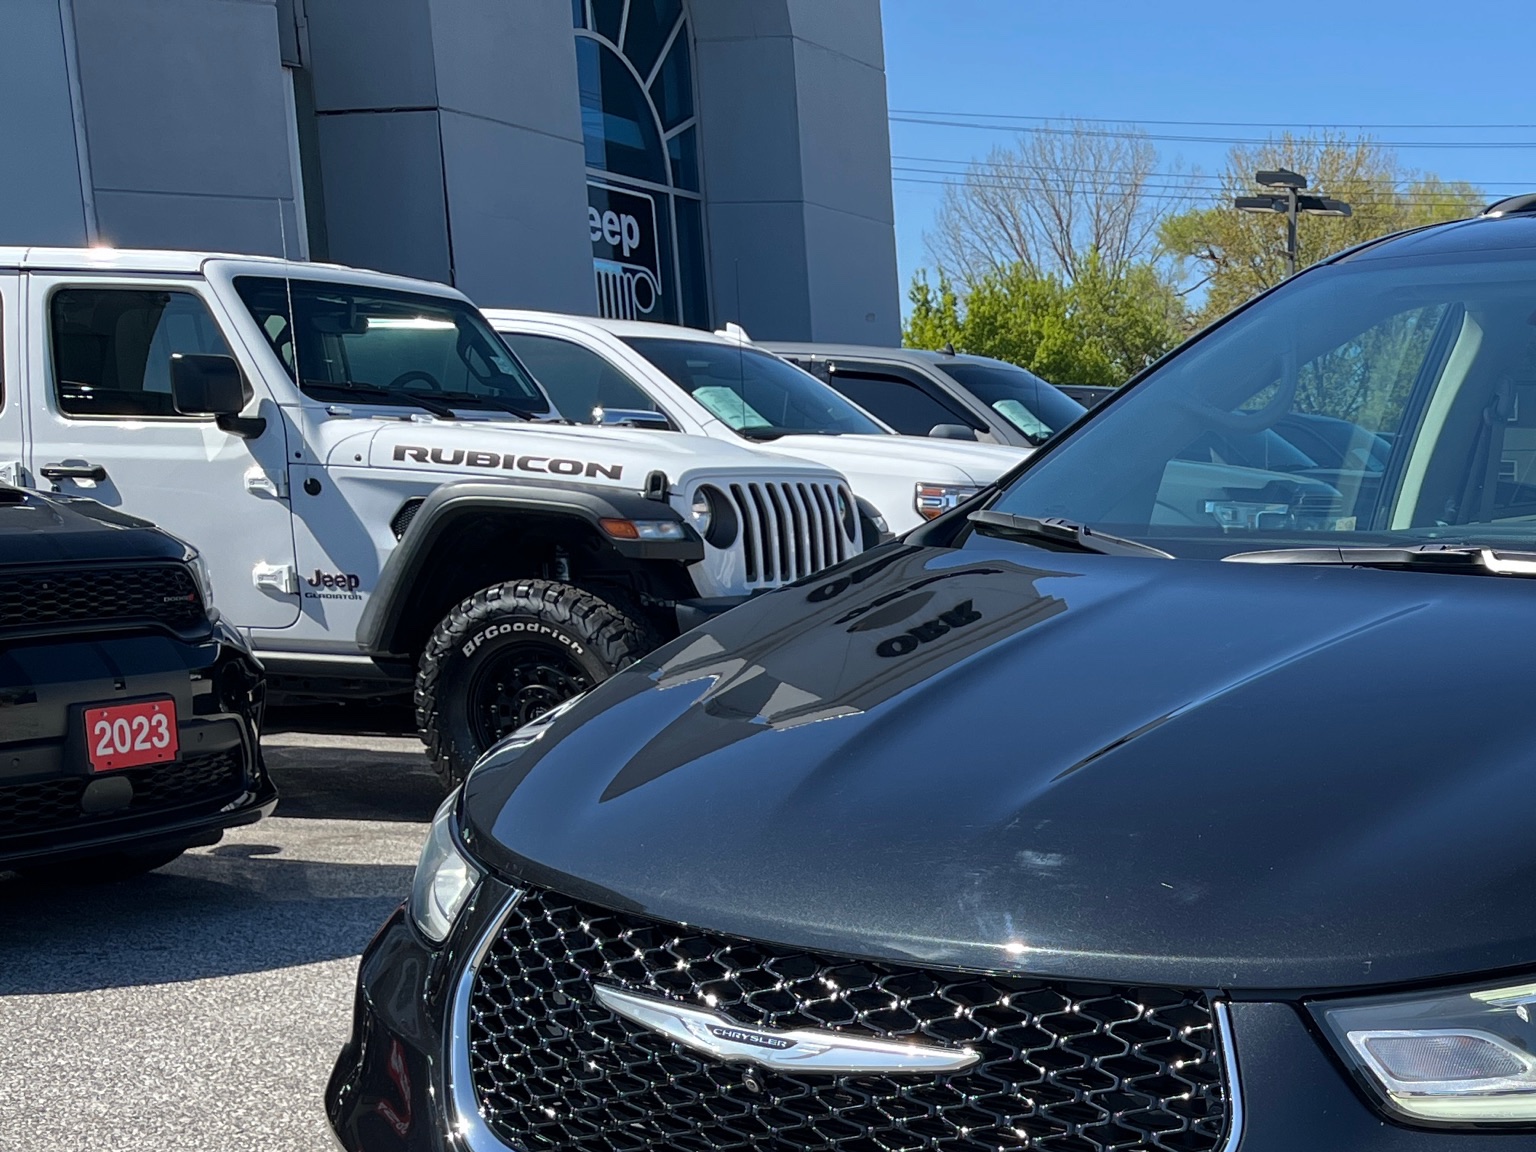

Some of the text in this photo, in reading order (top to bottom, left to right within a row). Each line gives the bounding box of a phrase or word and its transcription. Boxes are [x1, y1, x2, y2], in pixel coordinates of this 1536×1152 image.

[588, 206, 640, 257] eep
[393, 445, 623, 480] RUBICON
[304, 592, 363, 601] GLADIATOR
[308, 569, 360, 592] Jeep
[461, 621, 585, 658] BFGoodrich
[94, 713, 170, 757] 2023
[713, 1028, 788, 1048] CHRYSLER
